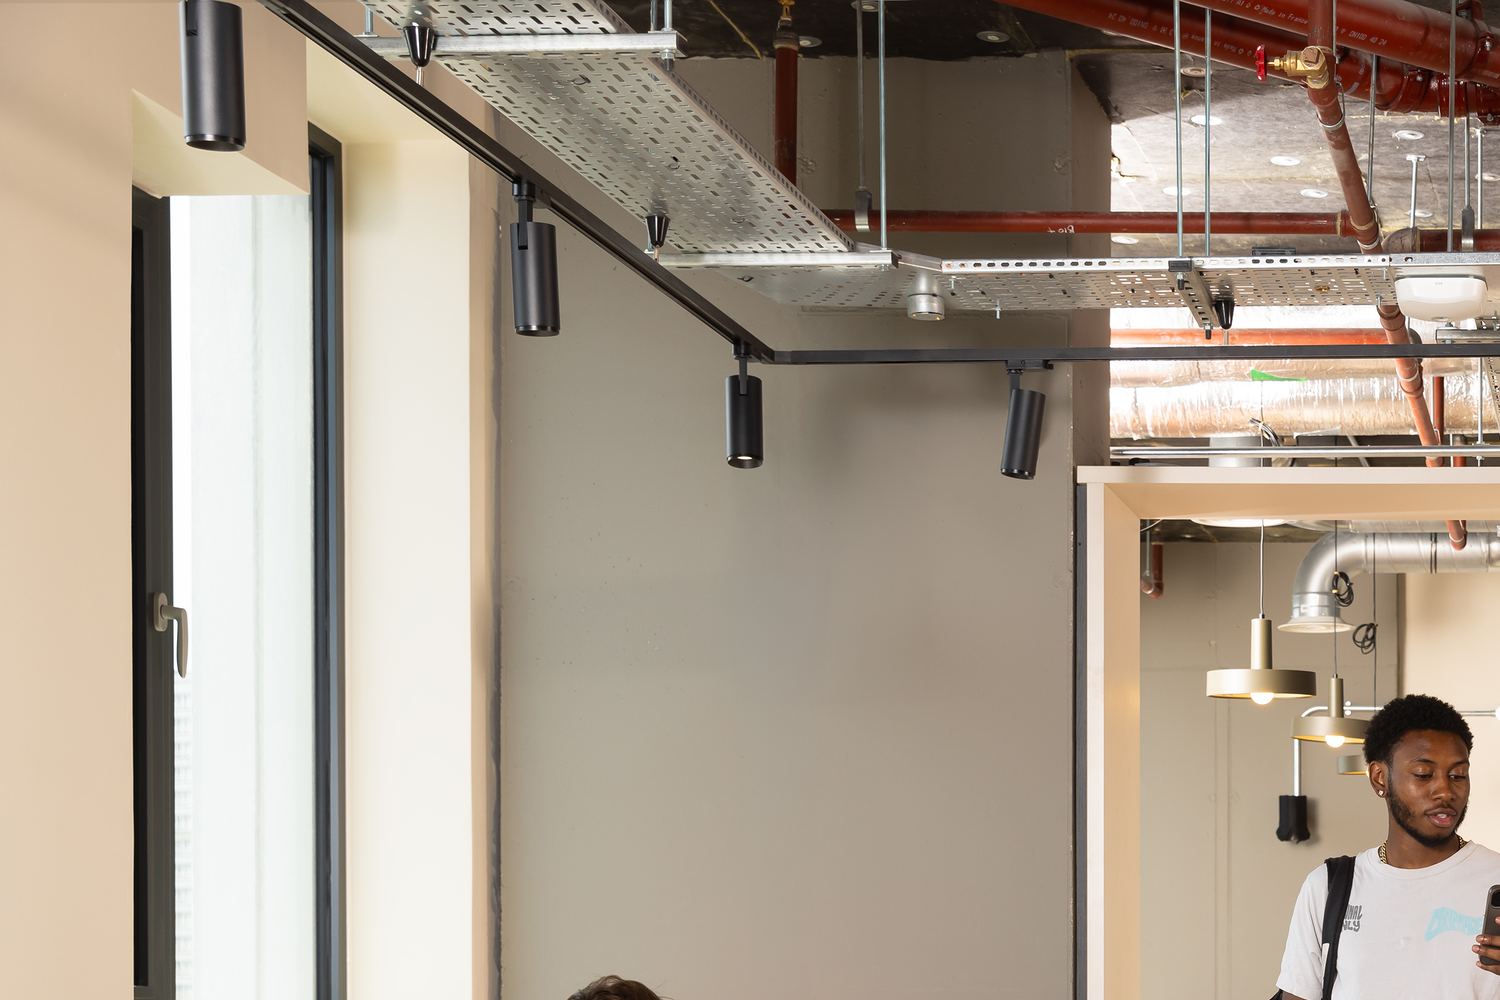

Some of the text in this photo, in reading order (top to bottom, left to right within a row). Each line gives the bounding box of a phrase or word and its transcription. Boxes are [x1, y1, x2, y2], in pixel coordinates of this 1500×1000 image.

[1108, 11, 1116, 20] 24
[1261, 6, 1276, 15] Made
[1287, 12, 1309, 25] France
[1190, 34, 1205, 42] ance
[1348, 29, 1367, 41] DN100
[1377, 38, 1387, 46] 24
[1343, 920, 1360, 932] NLY
